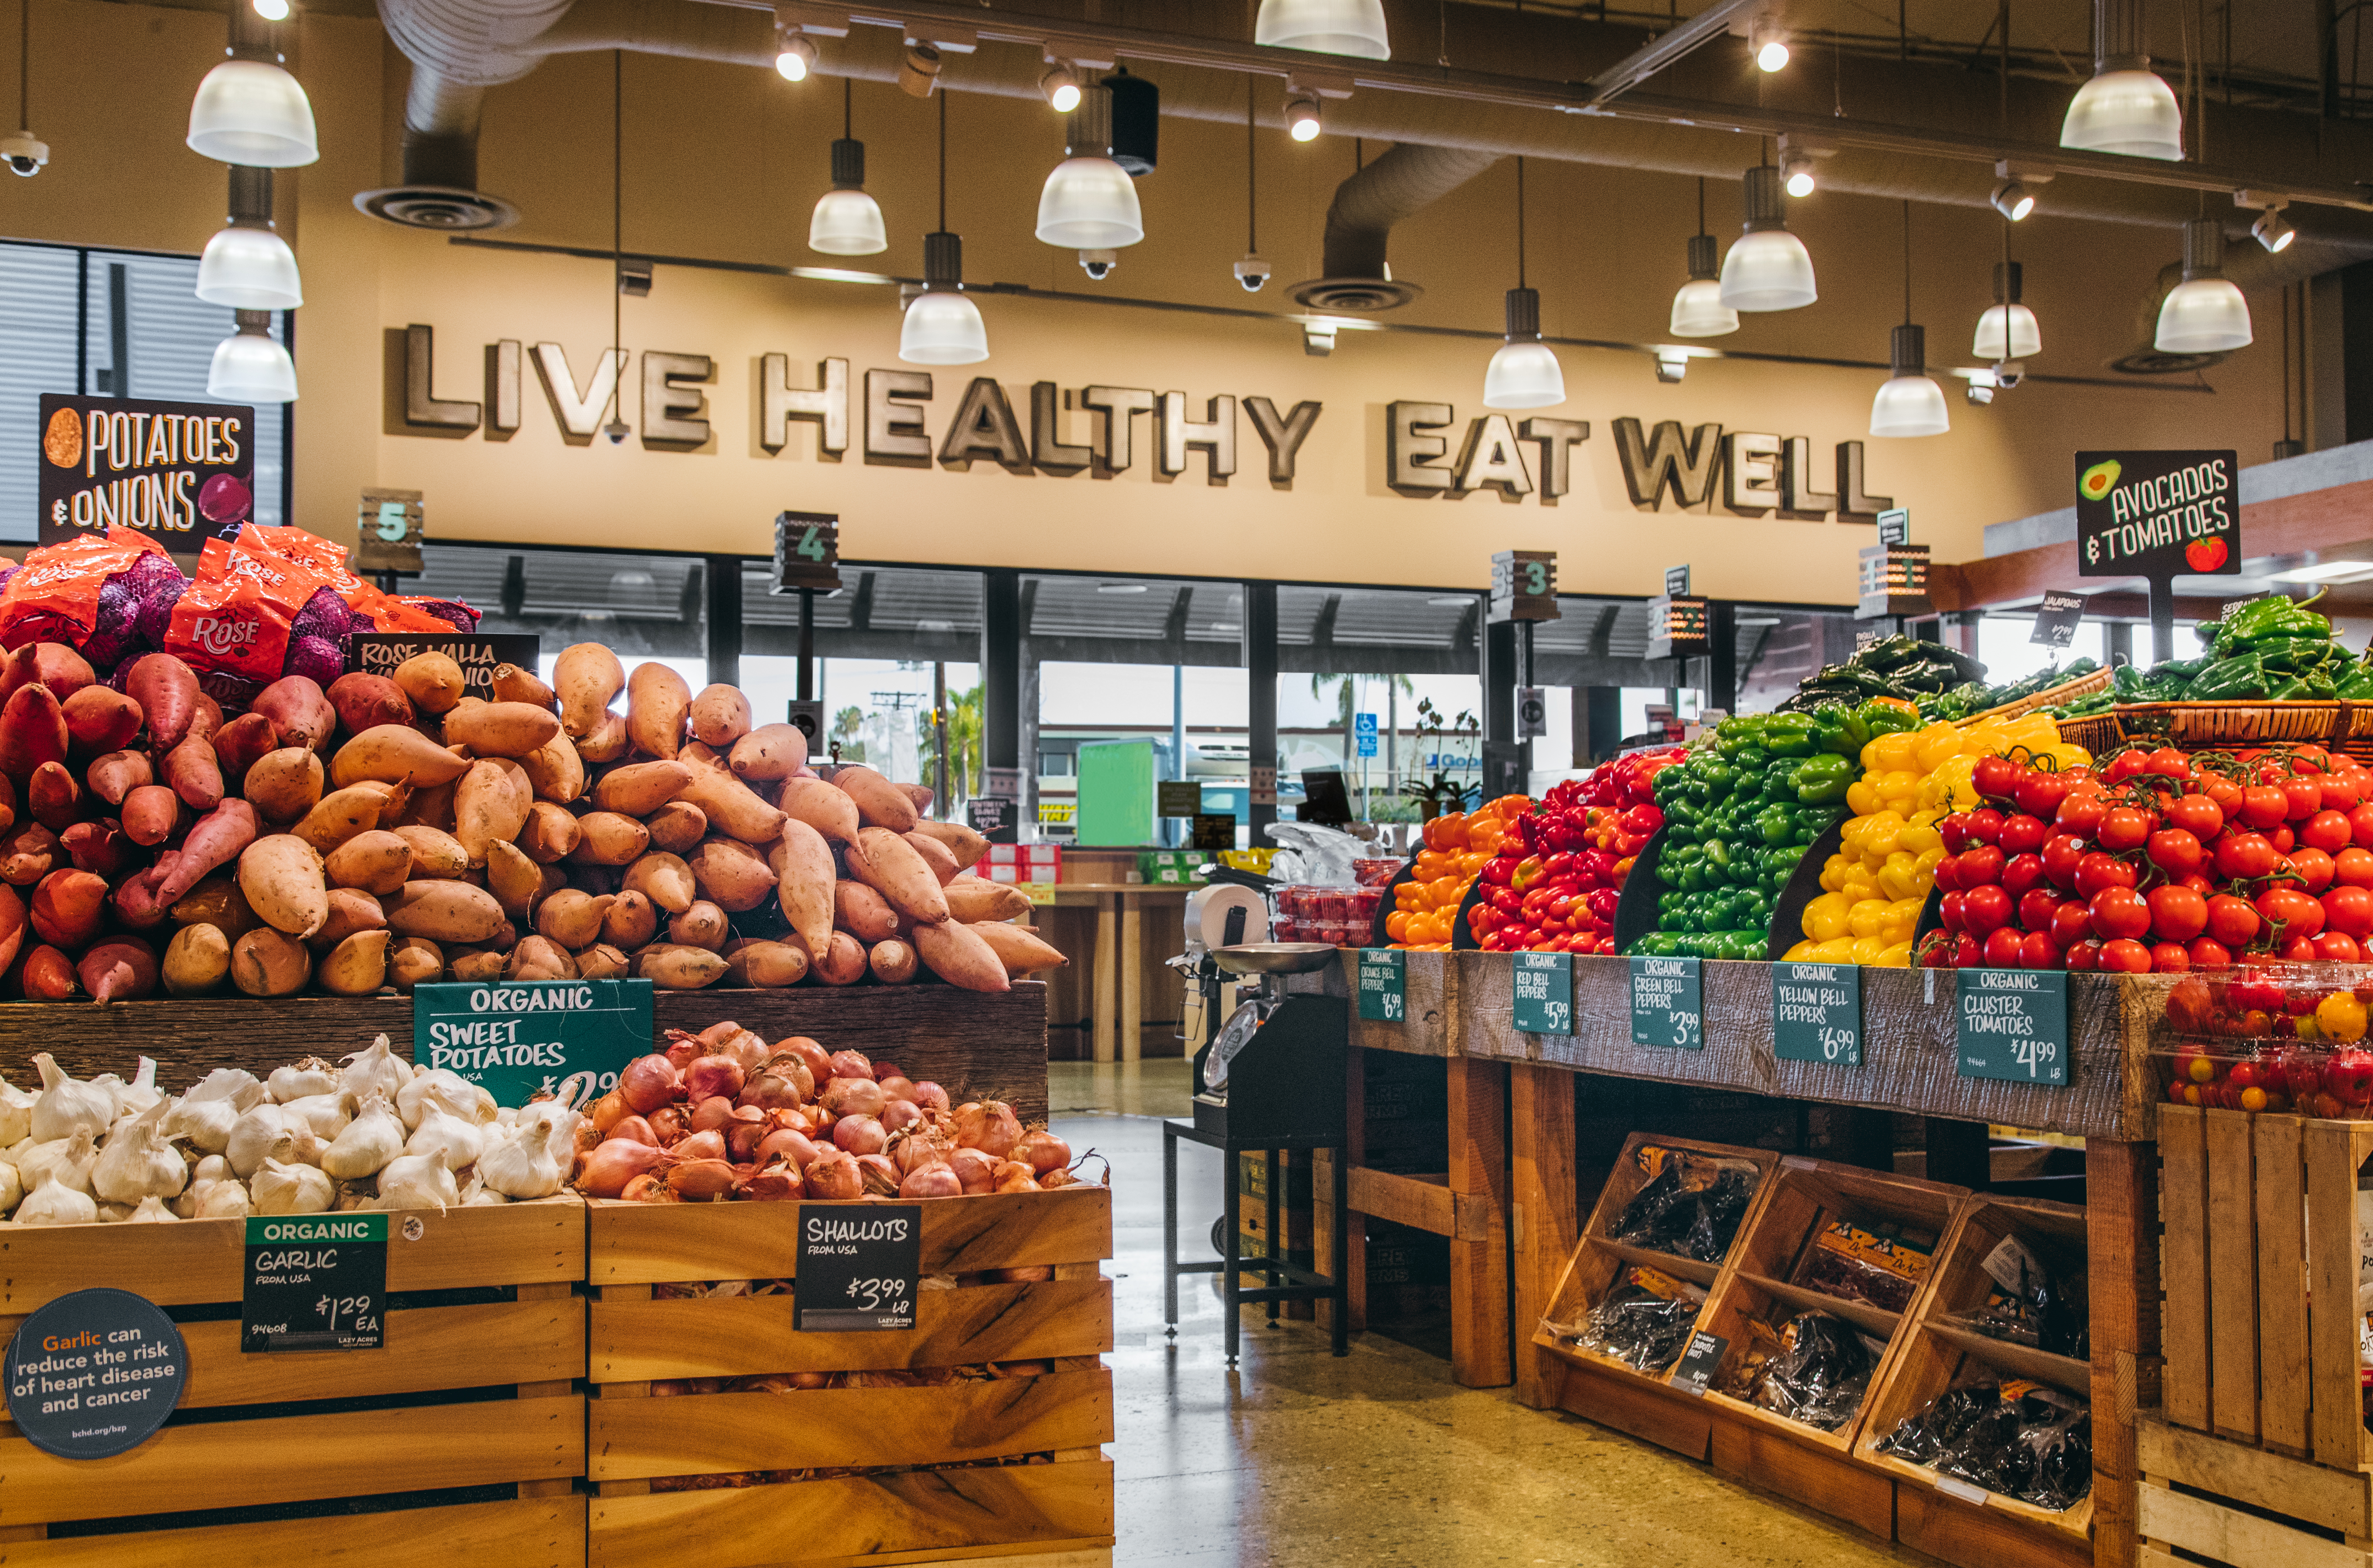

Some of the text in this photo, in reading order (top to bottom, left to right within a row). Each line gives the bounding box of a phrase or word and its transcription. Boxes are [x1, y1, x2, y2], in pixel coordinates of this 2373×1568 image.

[403, 323, 1894, 520] LIVE HEALTHY EAT WELL
[87, 410, 241, 477] POTATOES
[52, 470, 197, 531] & ONIONS
[2110, 458, 2229, 524] AVOCADOS
[376, 502, 407, 541] 5
[2086, 496, 2230, 565] & TOMATOES
[797, 527, 825, 561] 4
[1526, 561, 1546, 595] 3
[1682, 607, 1699, 634] 2
[192, 617, 260, 655] ROSÉ
[361, 643, 417, 665] ROSE
[1368, 951, 1392, 963] ORGANIC
[1526, 954, 1557, 968] ORGANIC
[1361, 967, 1396, 980] ORANGE BELL
[1645, 959, 1685, 976] ORGANIC
[1792, 965, 1837, 981] ORGANIC
[1361, 978, 1384, 991] PEPPERS
[1517, 972, 1549, 986] RED BELL
[1635, 976, 1684, 994] GREEN BELL
[1980, 972, 2038, 989] ORGANIC
[470, 987, 593, 1012] ORGANIC
[1517, 986, 1547, 999] PEPPERS
[1636, 993, 1671, 1009] PEPPERS
[1779, 985, 1848, 1006] YELLOW BELL
[1780, 1004, 1826, 1024] PEPPERS
[1965, 995, 2024, 1015] CLUSTER
[429, 1019, 522, 1049] SWEET
[1965, 1015, 2033, 1035] TOMATOES
[1692, 1034, 1699, 1044] LB
[430, 1042, 566, 1069] POTATOES
[1849, 1051, 1857, 1063] LB
[2051, 1067, 2060, 1079] LB
[264, 1223, 369, 1240] ORGANIC
[807, 1218, 908, 1242] SHALLOTS
[808, 1245, 858, 1255] FROM USA
[255, 1249, 337, 1272] GARLIC
[255, 1274, 311, 1285] FROM USA
[892, 1301, 909, 1313] LB
[252, 1323, 287, 1334] 94608
[355, 1316, 379, 1331] EA
[43, 1329, 141, 1351] Garlic can
[18, 1341, 169, 1376] reduce the risk
[13, 1365, 175, 1396] of heart disease
[42, 1388, 151, 1413] and cancer
